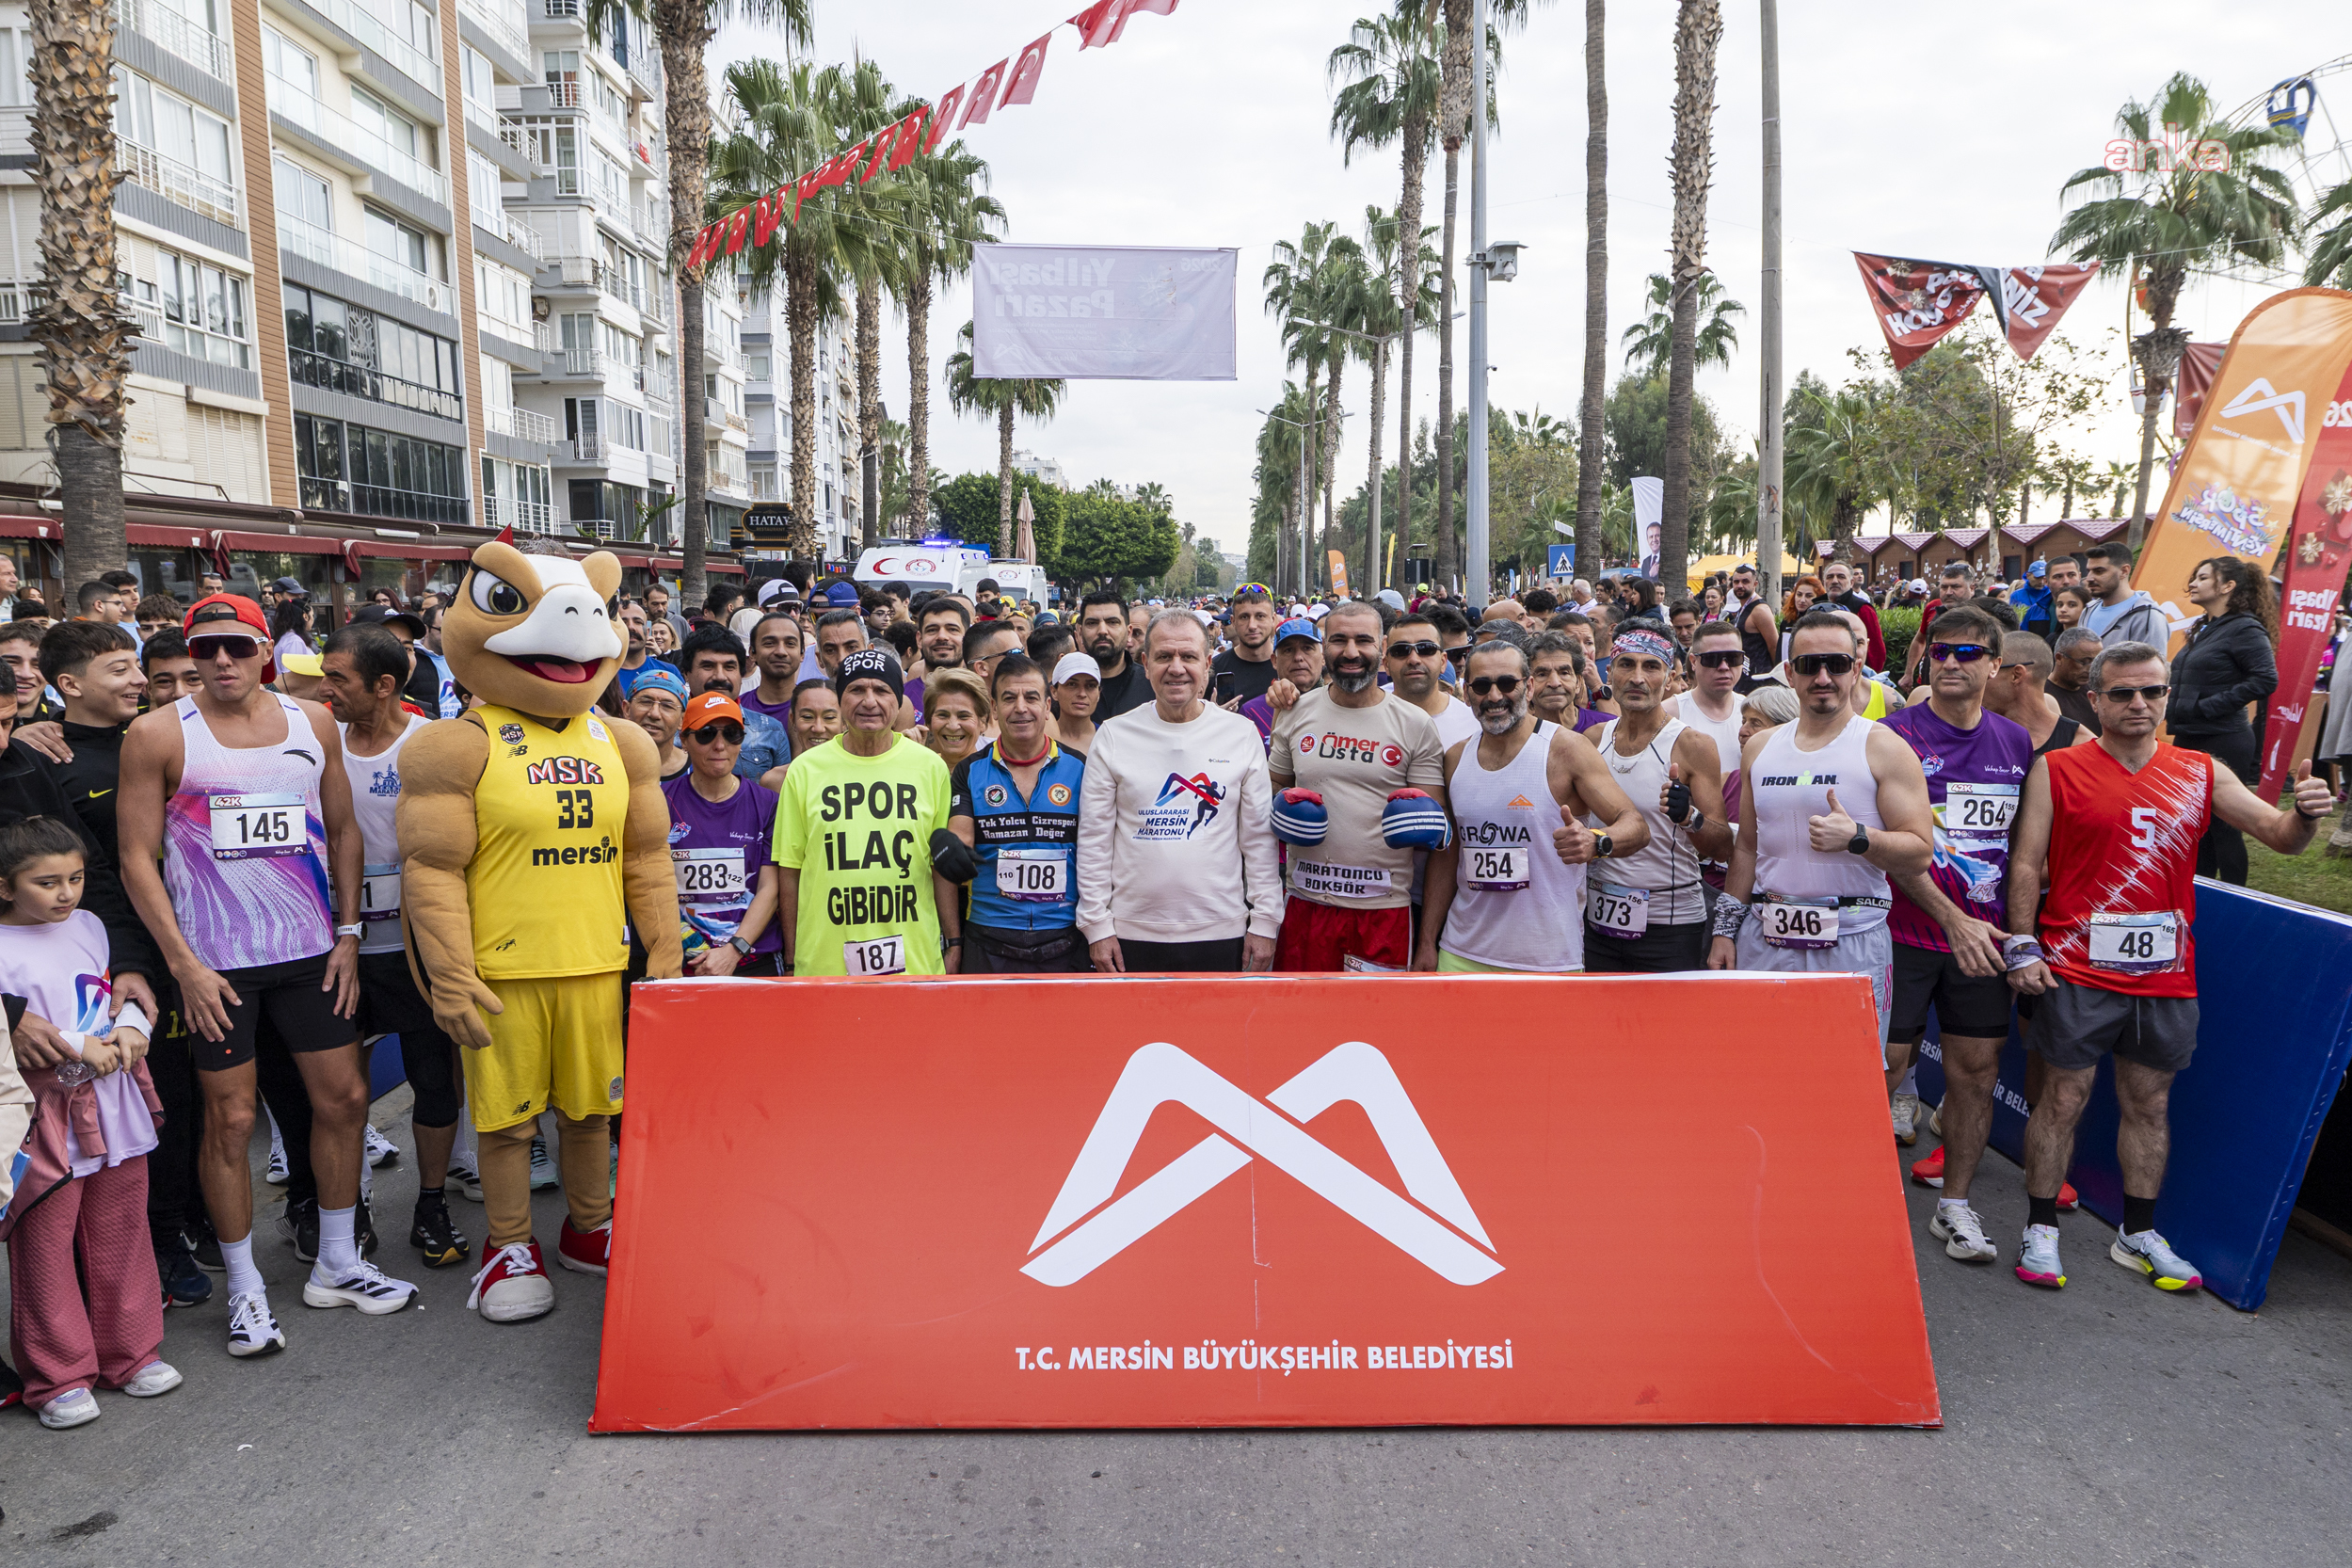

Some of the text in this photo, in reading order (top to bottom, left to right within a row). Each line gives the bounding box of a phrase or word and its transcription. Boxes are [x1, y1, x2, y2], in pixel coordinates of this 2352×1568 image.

[749, 515, 790, 526] HATAY
[844, 659, 885, 676] SPOR
[502, 729, 524, 742] MSK
[1321, 732, 1380, 752] Ömer
[527, 756, 604, 784] MSK
[1761, 770, 1838, 786] IRONMAN
[1951, 784, 1973, 793] 42K
[215, 796, 242, 807] 42K
[556, 789, 594, 829] 33
[821, 781, 919, 822] SPOR
[2005, 803, 2016, 811] 155
[978, 819, 996, 828] Tek
[999, 817, 1026, 826] Yolcu
[1145, 815, 1188, 826] MERSİN
[1963, 799, 2006, 826] 264
[236, 811, 289, 843] 145
[983, 827, 1065, 840] Ramazan Değer
[2132, 807, 2156, 847] 5
[533, 836, 618, 866] mersin
[672, 851, 691, 859] 42K
[824, 830, 915, 878] İLAÇ
[1001, 850, 1022, 858] 42K
[1297, 861, 1384, 880] MARATONCU
[1474, 852, 1513, 878] 254
[684, 863, 728, 890] 283
[728, 873, 743, 883] 122
[1016, 864, 1056, 889] 108
[1304, 878, 1366, 894] BOKSÖR
[827, 884, 919, 925] GİBİDİR
[1627, 895, 1642, 904] 156
[1594, 896, 1631, 926] 373
[2096, 915, 2120, 925] 42K
[1775, 907, 1822, 936] 346
[2162, 925, 2176, 935] 165
[2119, 931, 2154, 959] 48
[856, 941, 897, 972] 187
[2005, 1090, 2030, 1118] BELE
[1016, 1338, 1513, 1377] T.C. MERSİN BÜYÜKŞEHİR BELEDİYESİ
